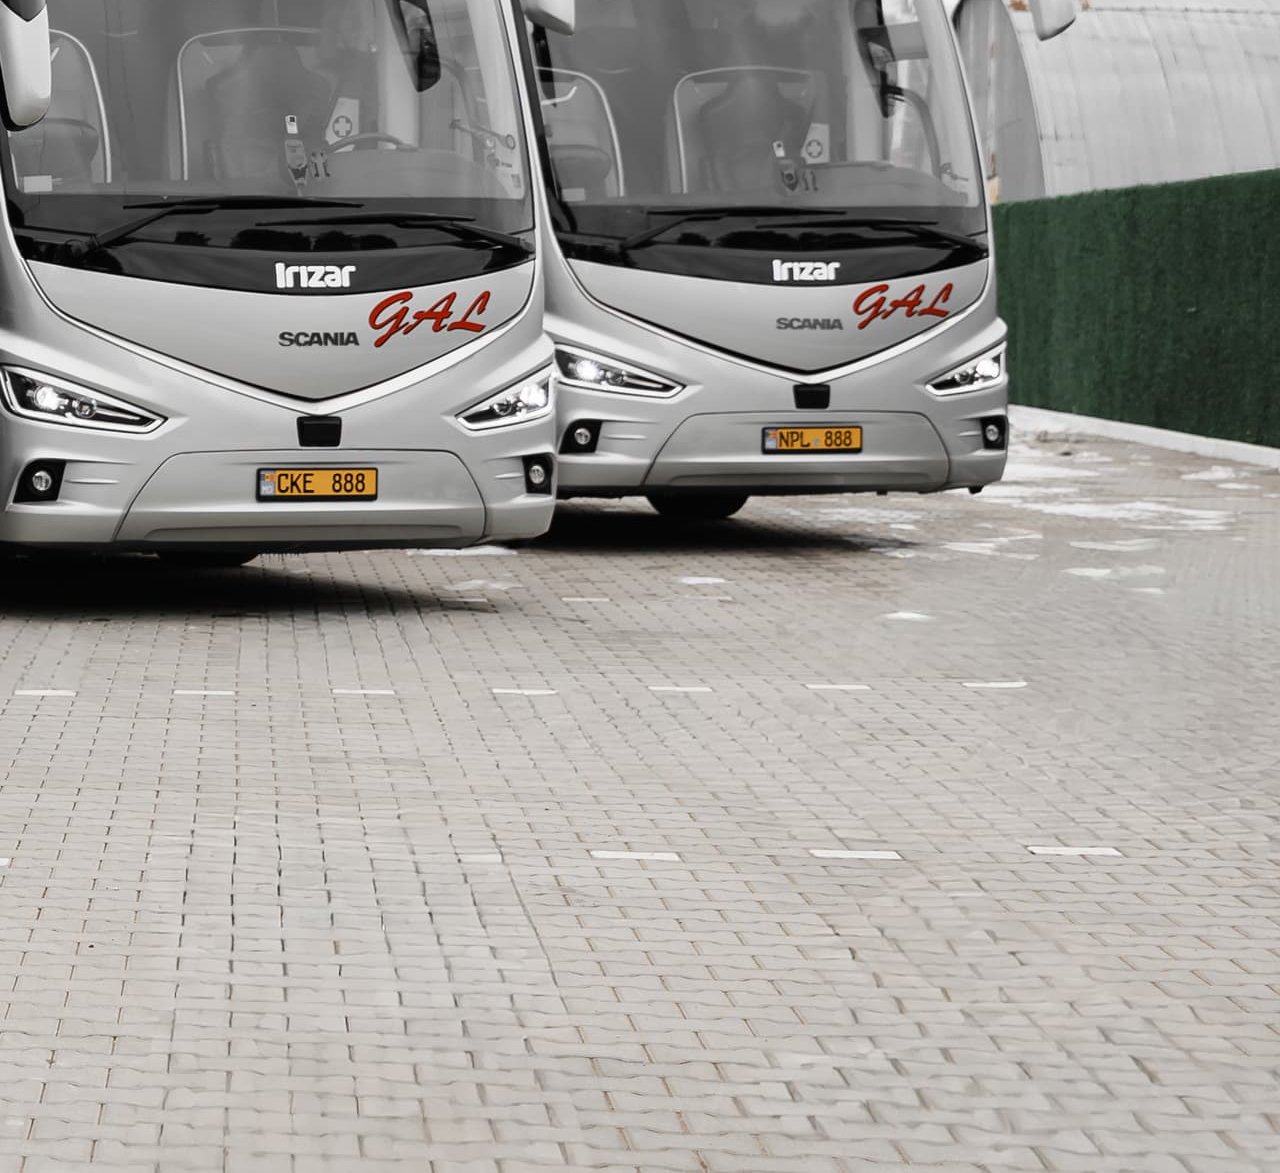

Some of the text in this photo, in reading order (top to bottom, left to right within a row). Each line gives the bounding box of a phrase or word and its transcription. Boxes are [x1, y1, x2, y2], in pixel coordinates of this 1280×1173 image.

[852, 282, 954, 329] GAL
[368, 290, 491, 348] GAL
[776, 317, 844, 331] SCANIA
[278, 331, 360, 347] SCANIA
[779, 431, 810, 448] NPL
[824, 430, 852, 447] 888
[277, 473, 315, 494] CKE
[332, 473, 366, 493] 888
